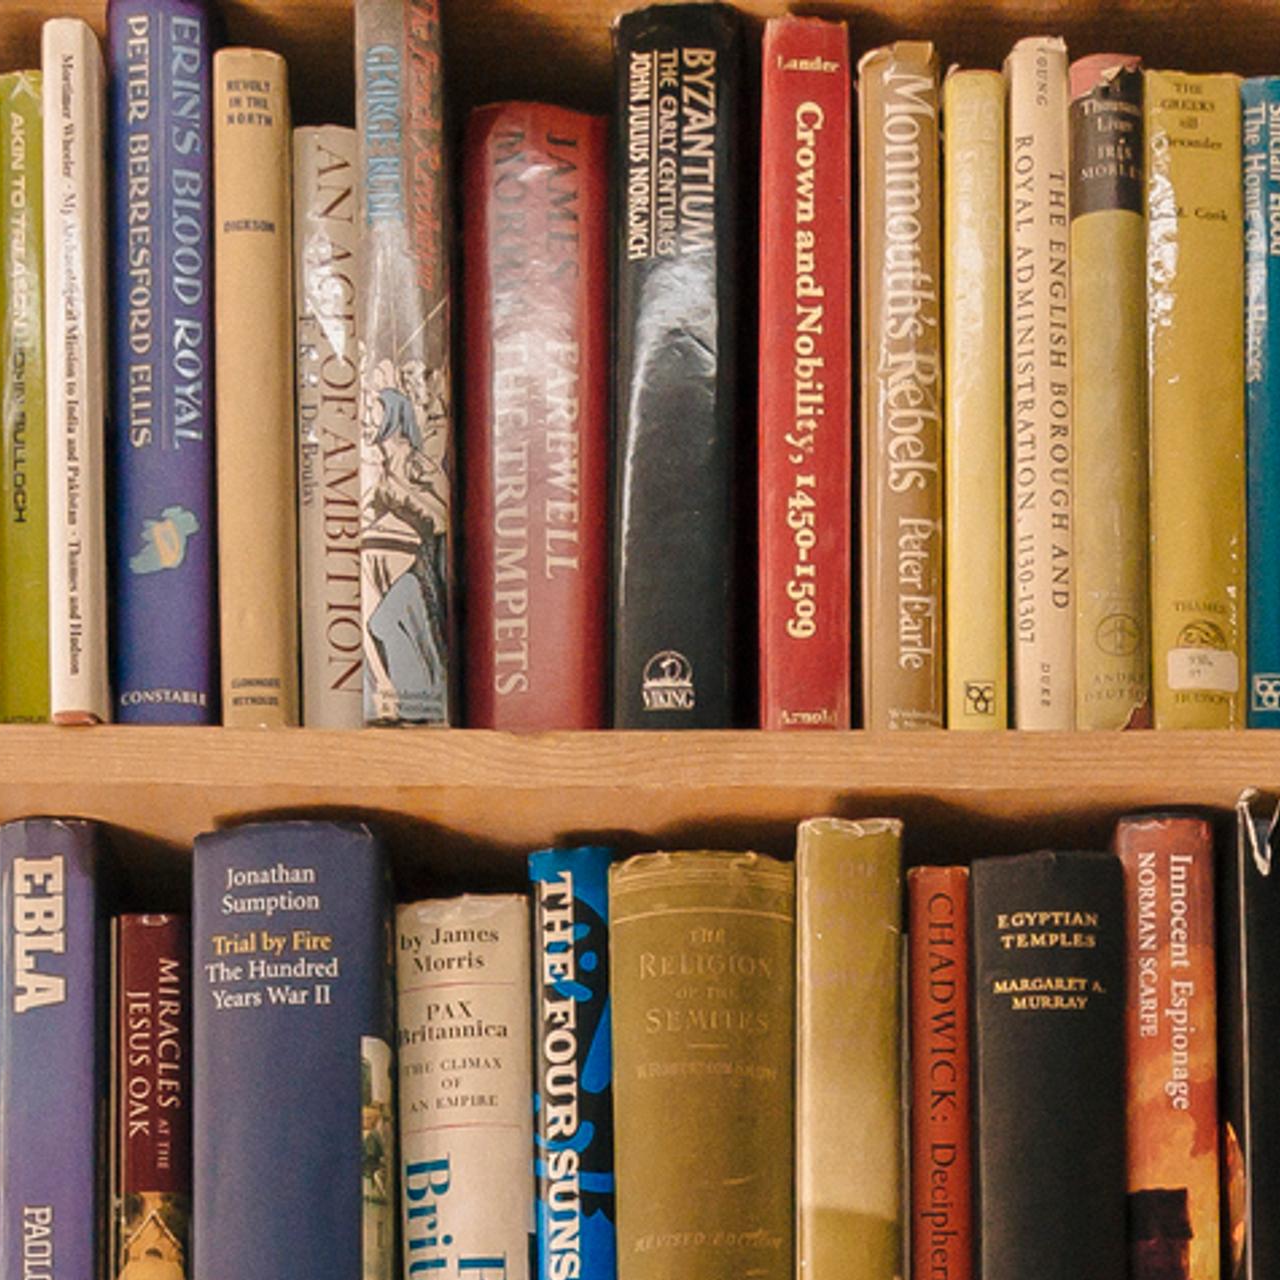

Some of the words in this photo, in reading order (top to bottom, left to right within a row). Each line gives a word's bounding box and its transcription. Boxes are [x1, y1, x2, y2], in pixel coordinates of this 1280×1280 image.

[127, 16, 150, 120] PETER
[681, 48, 716, 257] BYZANTIUM
[795, 102, 823, 222] Crown
[127, 134, 151, 355] BERRESFORD
[795, 230, 825, 297] and
[129, 364, 152, 448] ELLIS
[786, 306, 824, 463] Nobility,
[68, 541, 81, 590] Thames
[788, 475, 819, 637] 1450-1509
[69, 596, 81, 618] and
[69, 622, 82, 675] Hudson
[122, 690, 205, 706] CONSTABLE
[222, 891, 320, 915] Sumption
[225, 865, 315, 887] Jonathan
[1137, 852, 1157, 949] NORMAN
[1169, 854, 1193, 967] Innocent
[14, 855, 65, 1012] EBLA
[213, 932, 257, 954] Trial
[261, 932, 286, 955] by
[292, 932, 332, 951] Fire
[541, 871, 578, 983] THE
[1001, 931, 1096, 949] TEMPLES
[206, 961, 242, 981] The
[247, 958, 339, 979] Hundred
[213, 986, 258, 1009] Years
[262, 986, 304, 1006] War
[313, 985, 331, 1005] II
[927, 893, 957, 1122] CHADWICK:
[1012, 995, 1089, 1010] MURRAY
[1139, 956, 1159, 1038] SCARFE
[543, 997, 577, 1136] FOUR
[1166, 981, 1195, 1109] Espionage
